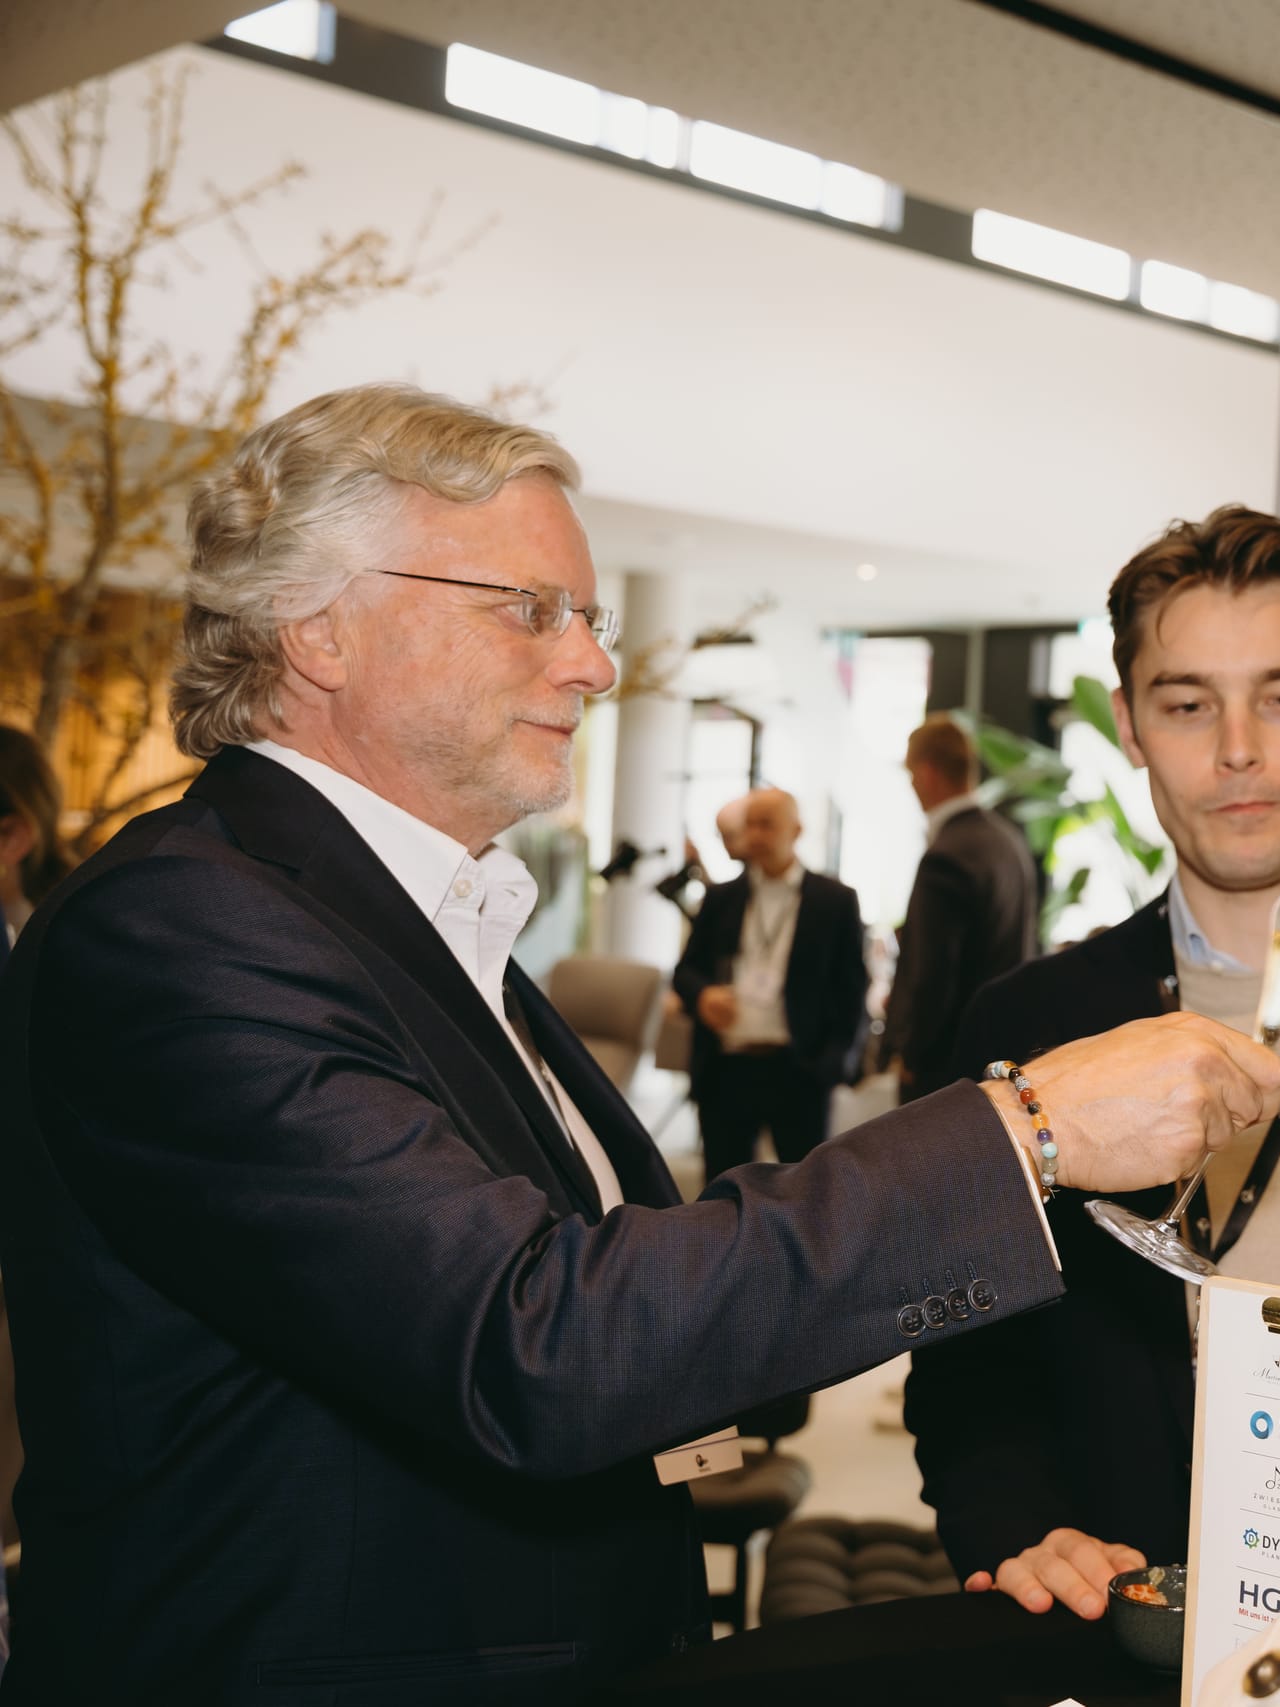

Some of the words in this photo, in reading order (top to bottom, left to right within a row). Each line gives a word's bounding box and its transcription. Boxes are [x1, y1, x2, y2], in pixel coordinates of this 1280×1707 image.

[1261, 1550, 1280, 1560] PLAN
[1238, 1607, 1249, 1617] Mit
[1250, 1611, 1261, 1620] uns
